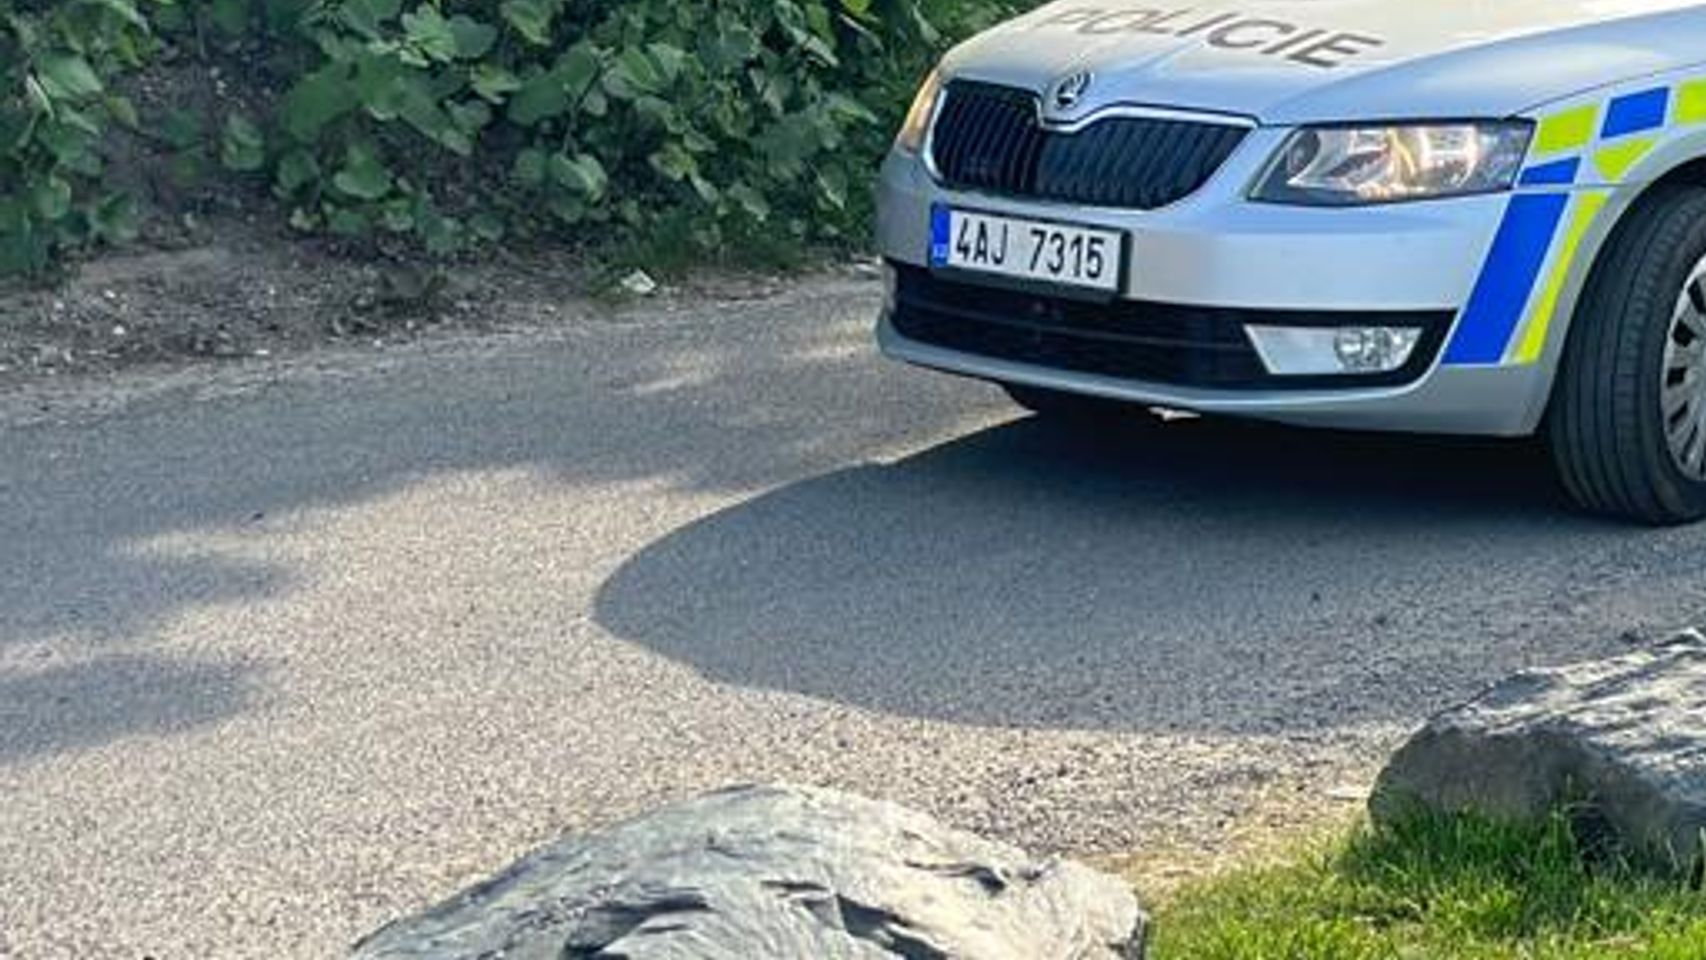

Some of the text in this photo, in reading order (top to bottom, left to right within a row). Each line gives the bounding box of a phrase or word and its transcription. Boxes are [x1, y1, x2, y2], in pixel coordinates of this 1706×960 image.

[1036, 7, 1384, 68] POLICIE
[956, 217, 1105, 279] 4AJ 7315
